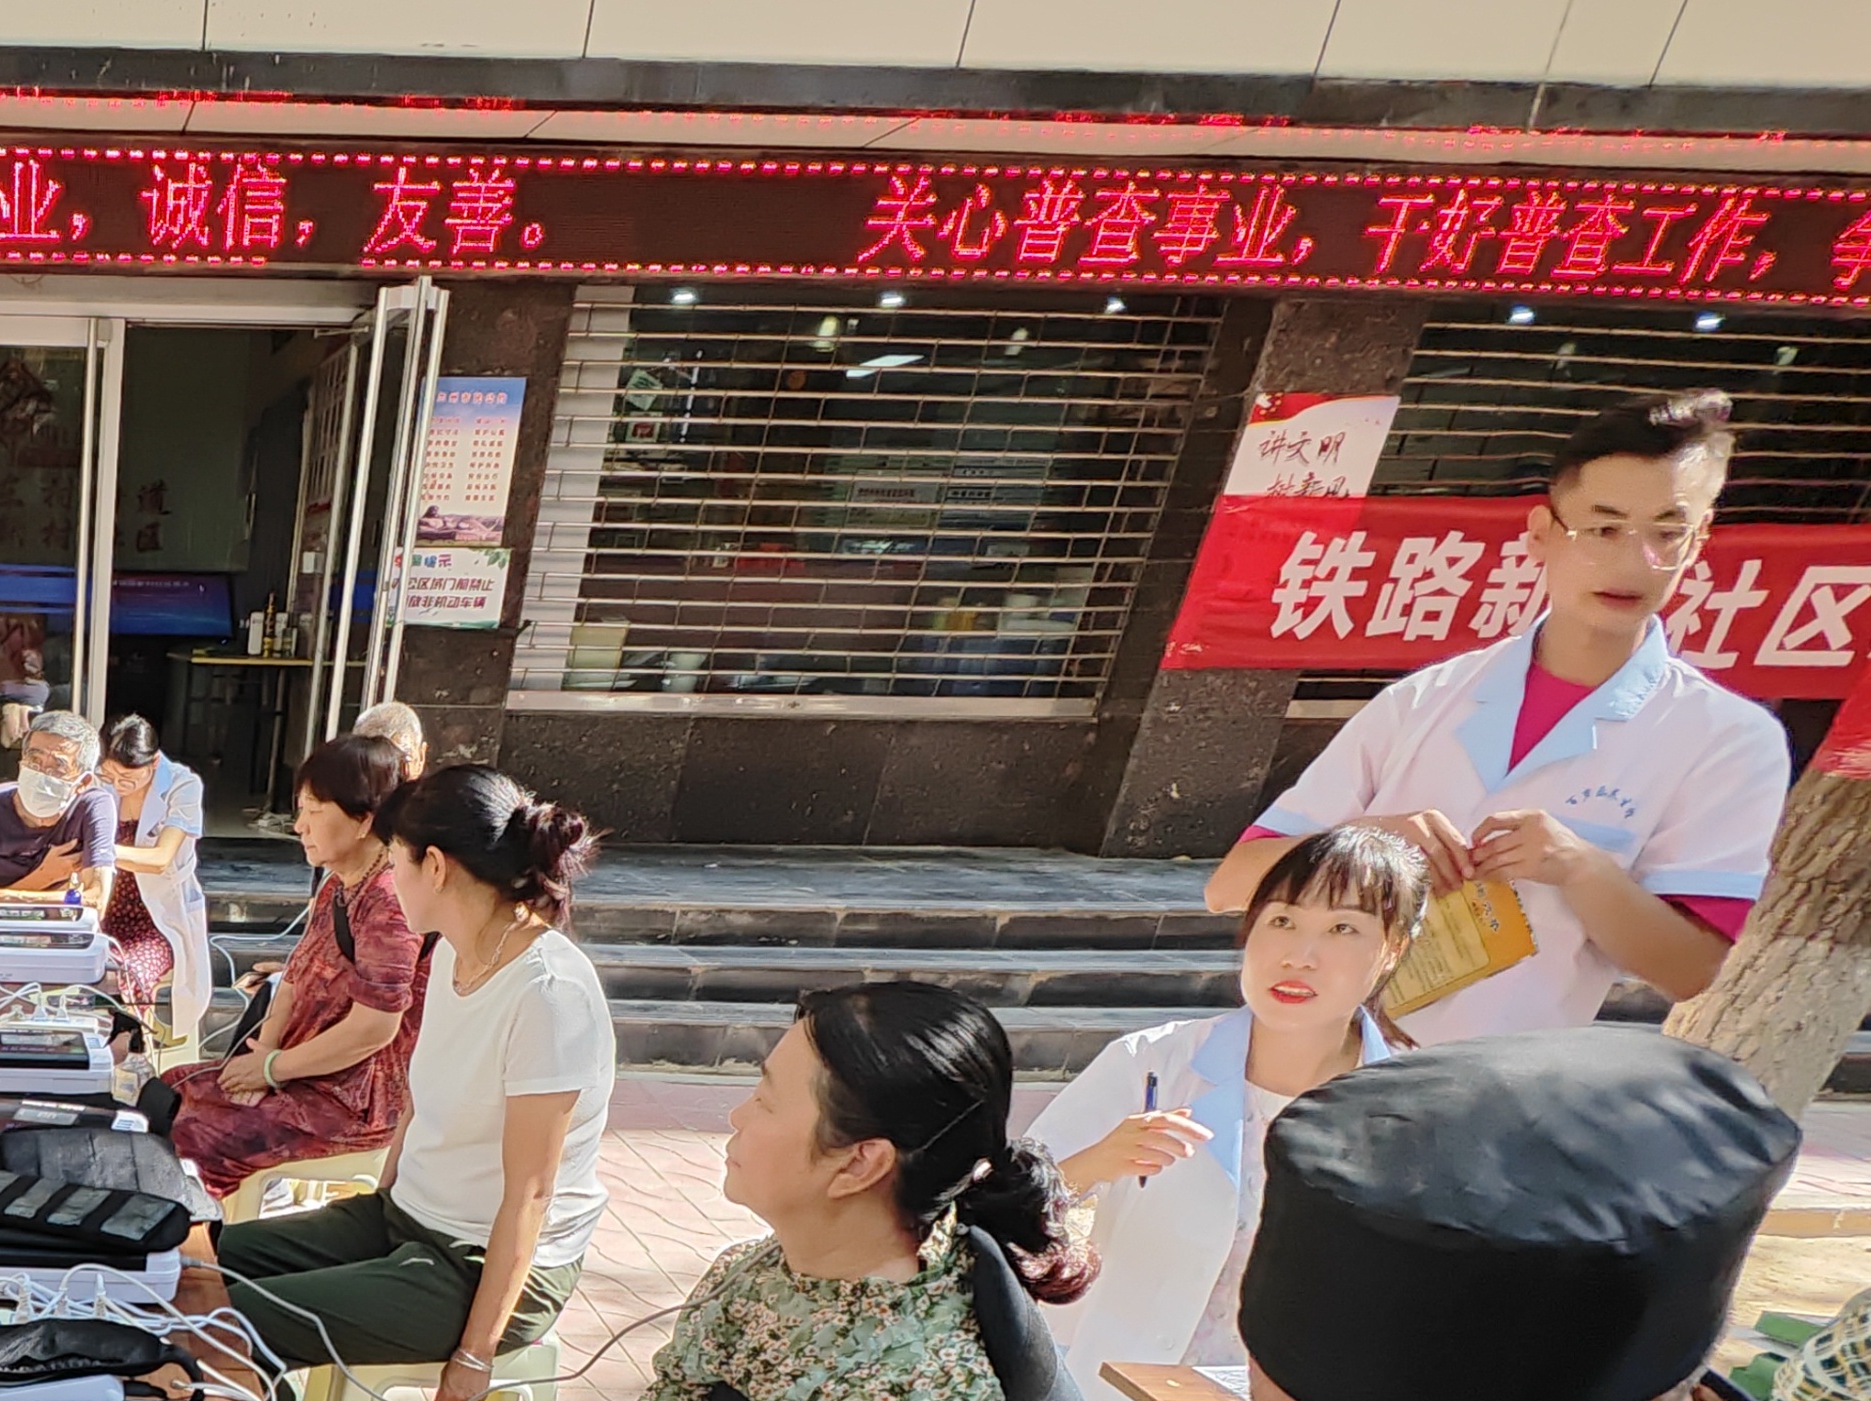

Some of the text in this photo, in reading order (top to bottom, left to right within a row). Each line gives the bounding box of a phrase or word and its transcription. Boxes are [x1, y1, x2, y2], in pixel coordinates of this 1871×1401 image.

[1259, 430, 1345, 465] 讲文明
[1266, 472, 1350, 498] 树新风
[407, 595, 487, 609] 放非机动车辆
[1270, 530, 1871, 668] 铁路新社区
